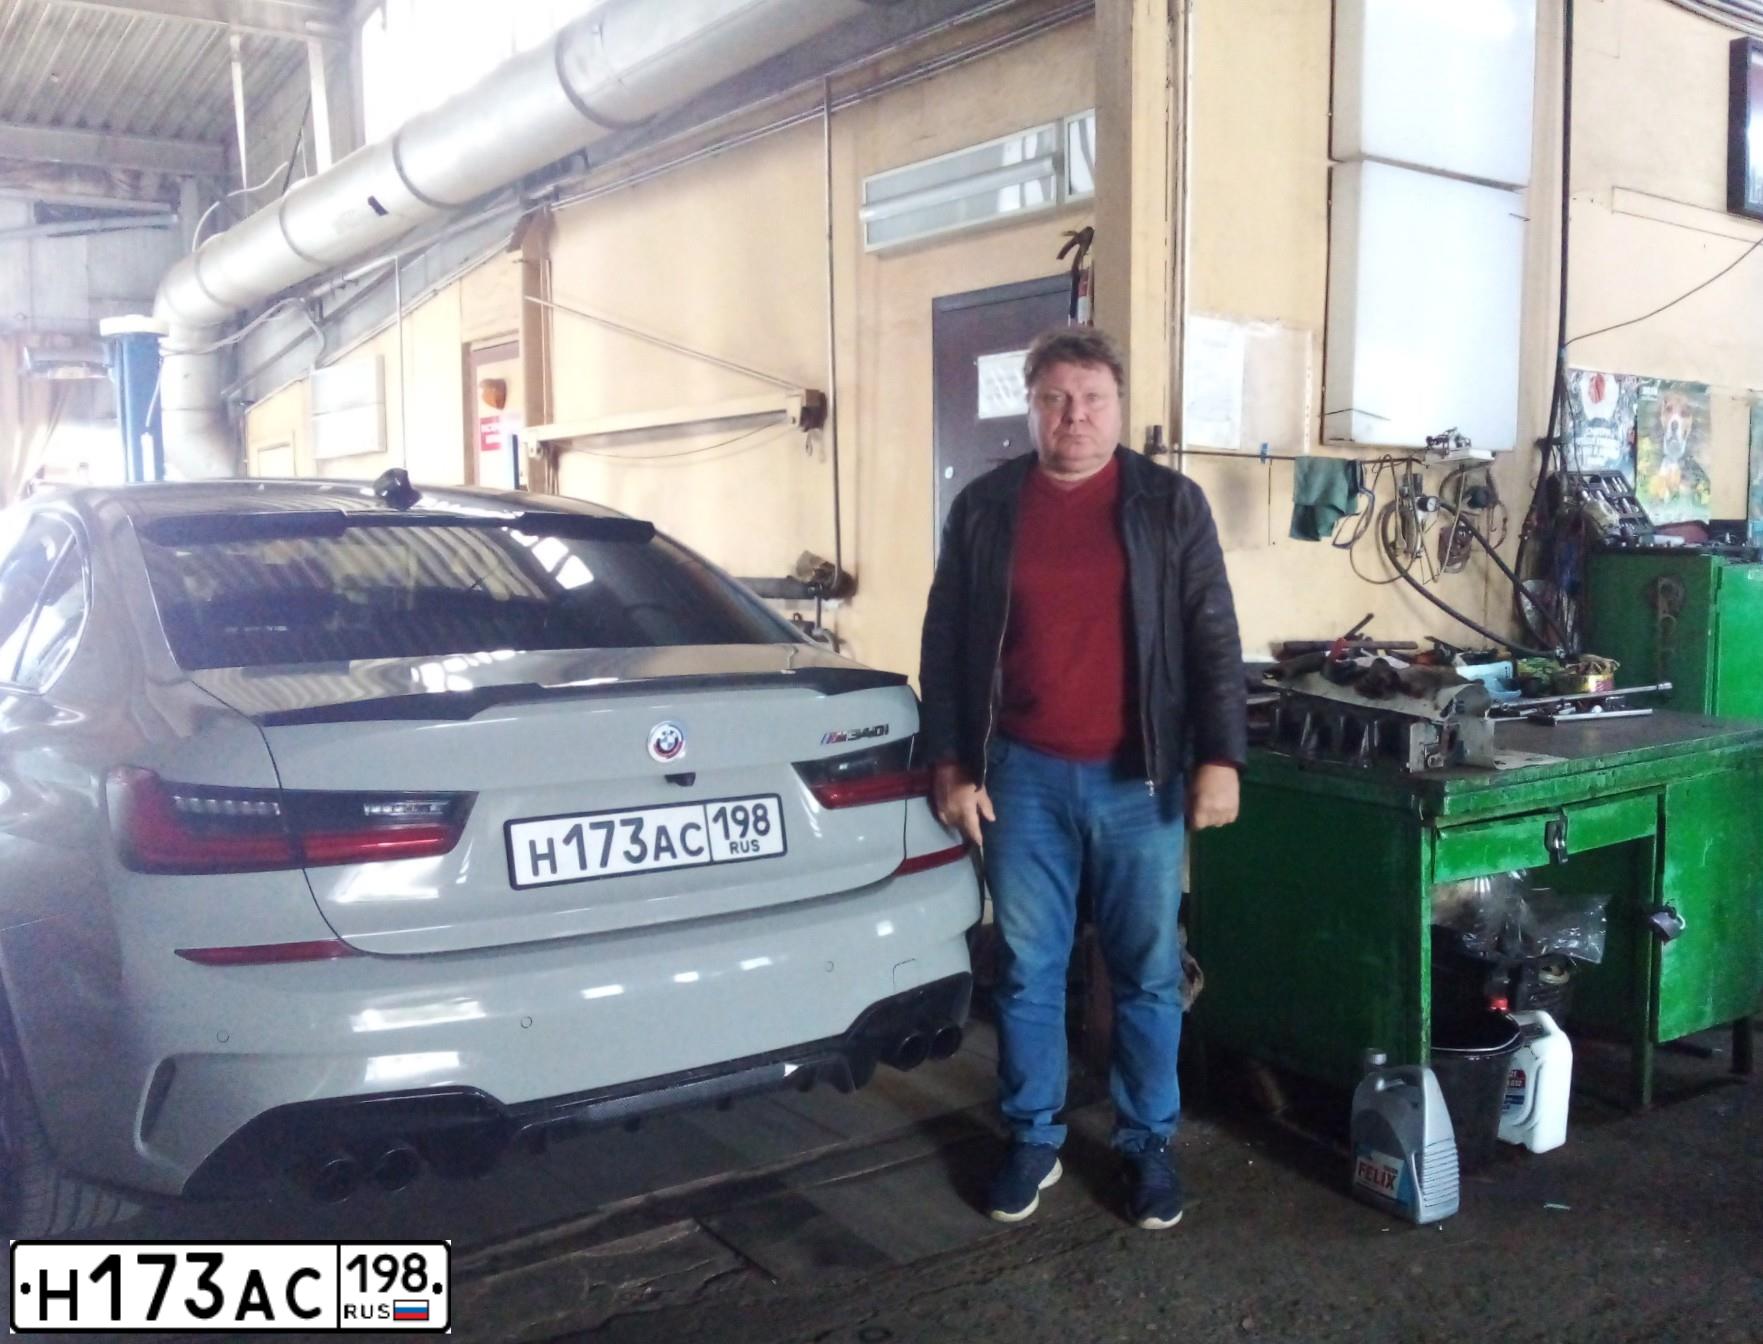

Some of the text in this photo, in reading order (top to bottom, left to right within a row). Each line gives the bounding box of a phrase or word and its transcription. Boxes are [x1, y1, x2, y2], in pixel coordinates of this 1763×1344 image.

[529, 803, 771, 877] Н173АС 198
[729, 839, 761, 855] RUS
[1358, 1162, 1397, 1190] FELIX
